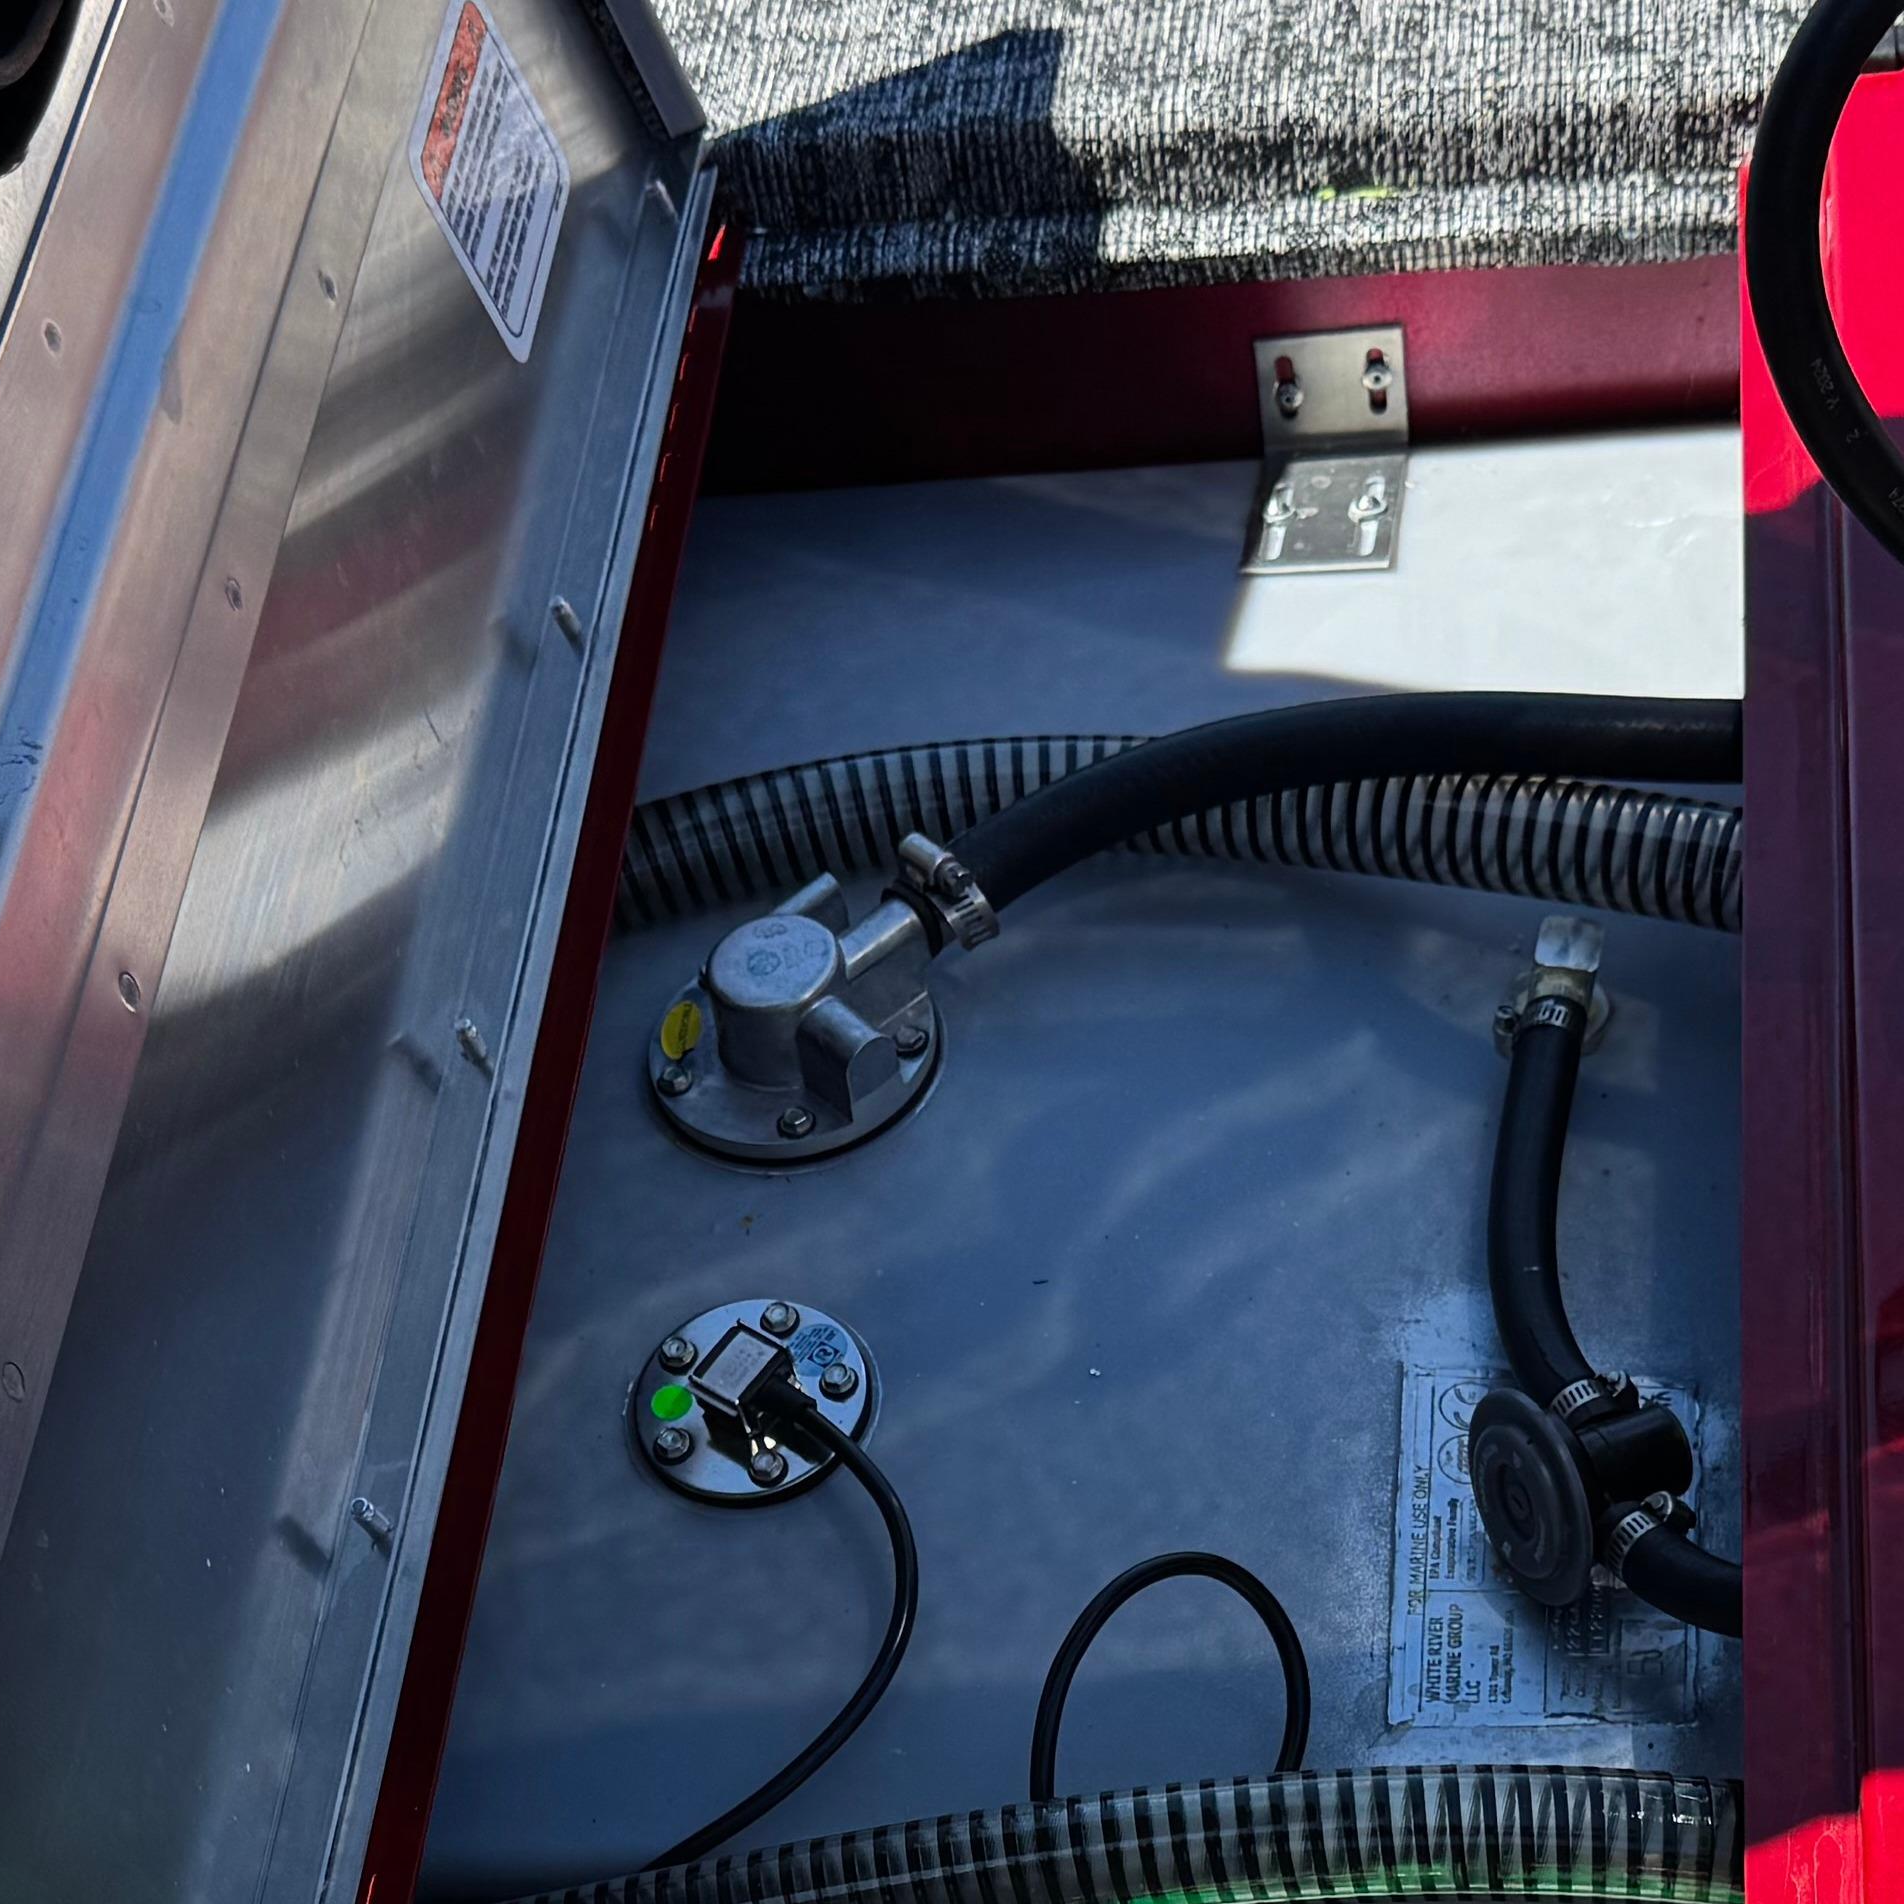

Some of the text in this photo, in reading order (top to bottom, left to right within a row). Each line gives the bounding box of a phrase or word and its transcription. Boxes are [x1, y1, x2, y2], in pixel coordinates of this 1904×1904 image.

[1412, 1464, 1430, 1499] ONLY
[1411, 1502, 1427, 1529] USE
[1408, 1533, 1426, 1584] MARINE
[1424, 1617, 1444, 1702] WHITE RIVER
